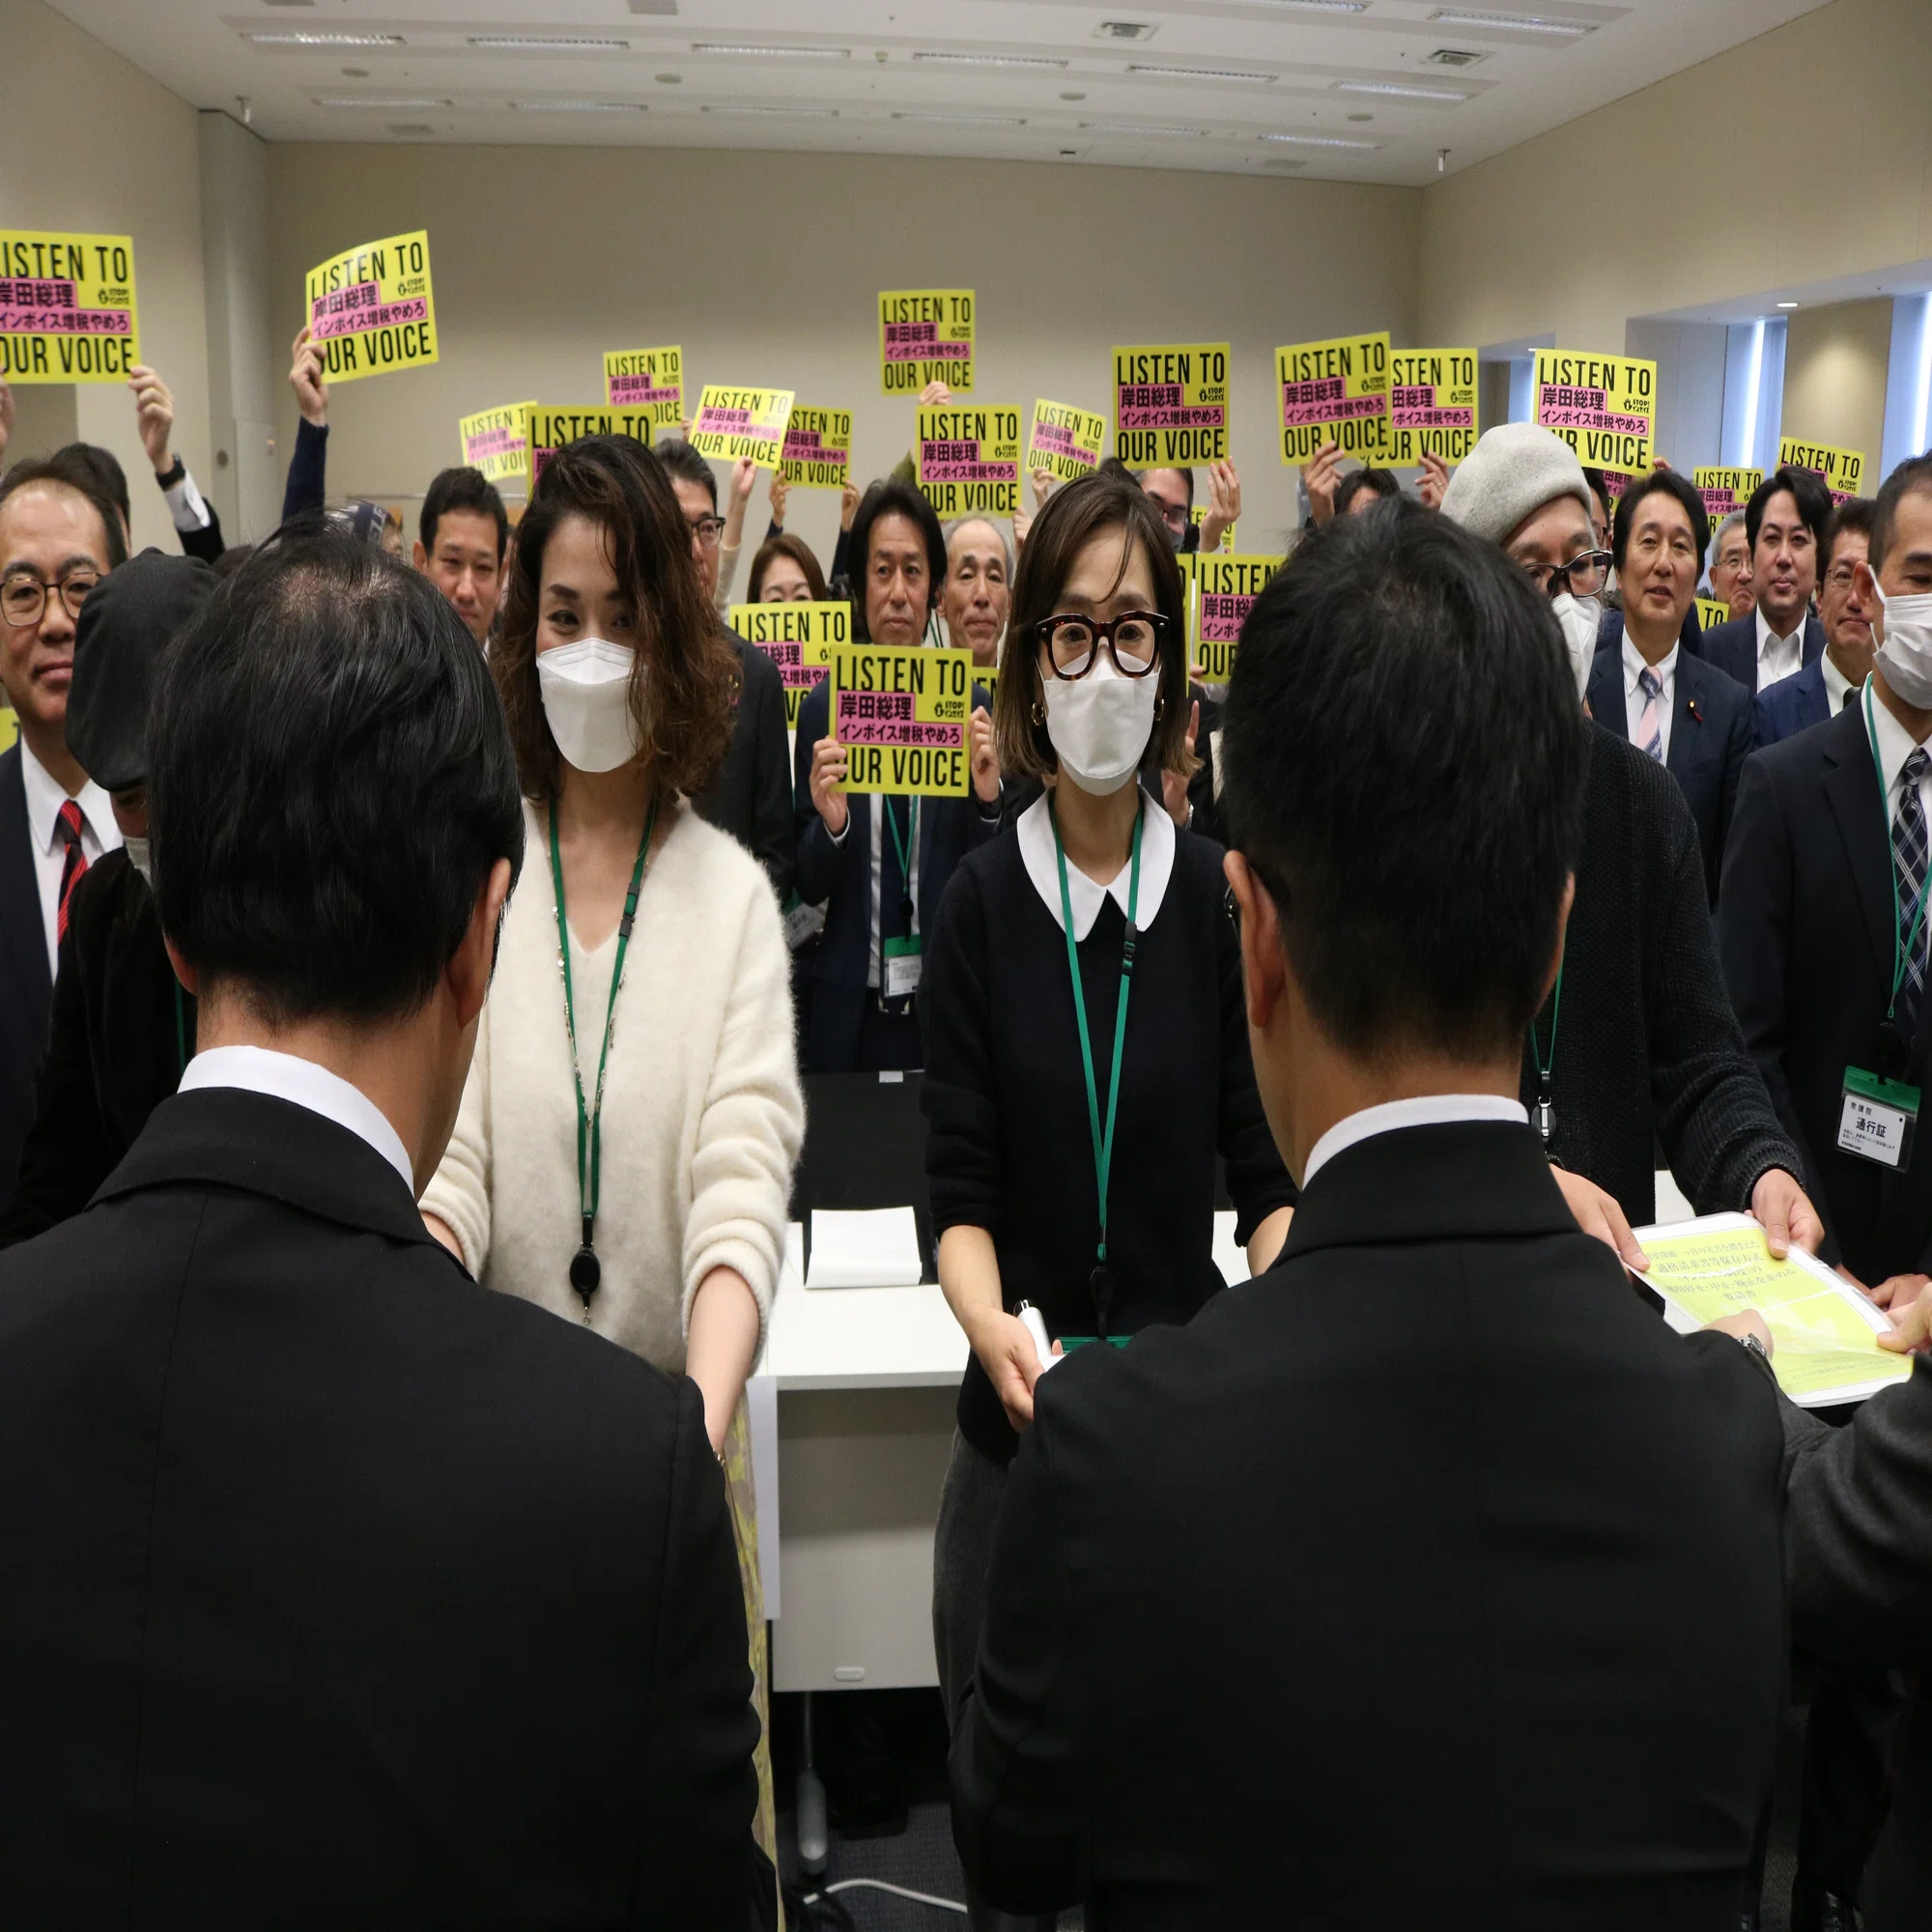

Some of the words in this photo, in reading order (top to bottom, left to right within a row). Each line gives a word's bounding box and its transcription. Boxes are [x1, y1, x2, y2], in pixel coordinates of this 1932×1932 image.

[0, 242, 84, 281] ISTEN
[95, 246, 128, 282] TO
[311, 250, 385, 302] LISTEN
[394, 242, 423, 276] TO
[314, 284, 377, 321] 岸田総理
[882, 298, 943, 324] LISTEN
[951, 297, 971, 323] TO
[315, 301, 425, 336] インボイス増税やめろ
[57, 337, 132, 374] VOICE
[320, 337, 356, 375] UR
[363, 322, 432, 366] VOICE
[607, 354, 656, 378] LISTEN
[662, 352, 679, 372] TO
[884, 363, 917, 389] OUR
[923, 361, 970, 387] VOICE
[1118, 354, 1190, 385] LISTEN
[1200, 352, 1225, 384] TO
[1281, 347, 1351, 384] LISTEN
[1360, 342, 1385, 374] TO
[1393, 357, 1441, 386] STEN
[1450, 356, 1473, 385] TO
[1540, 357, 1615, 391] LISTEN
[1625, 366, 1651, 397] TO
[703, 391, 761, 411] LISTEN
[769, 394, 789, 414] TO
[1122, 386, 1179, 408] 岸田総理
[1286, 380, 1343, 406] 岸田総理
[1392, 388, 1433, 409] 田総理
[1542, 387, 1605, 412] 岸田総理
[654, 402, 681, 423] ICE
[702, 409, 750, 423] 岸田総理
[787, 410, 828, 433] STEN
[834, 413, 850, 435] TO
[1037, 405, 1082, 433] LISTEN
[1087, 417, 1103, 440] TO
[1122, 409, 1222, 426] インボイス増税やめろ
[1287, 397, 1384, 423] インボイス増税やめろ
[1392, 411, 1471, 425] ボイス増税やめろ
[1542, 410, 1646, 434] インボイス増税やめろ
[465, 411, 512, 439] LISTEN
[622, 415, 649, 446] TO
[920, 413, 985, 441] LISTEN
[995, 412, 1017, 440] TO
[1285, 426, 1321, 458] OUR
[1329, 416, 1388, 451] VOICE
[692, 433, 724, 453] OUR
[729, 437, 779, 463] VOICE
[782, 447, 846, 462] ンボイス増税やめろ
[923, 442, 978, 462] 岸田総理
[1118, 431, 1157, 463] OUR
[1165, 428, 1224, 461] VOICE
[1419, 429, 1473, 459] VOICE
[1587, 431, 1648, 469] VOICE
[500, 450, 526, 471] VOI
[808, 462, 846, 485] VOICE
[923, 465, 1014, 478] インボイス増税やめろ
[1029, 450, 1053, 471] OUR
[1058, 456, 1093, 479] VOIC
[1781, 443, 1835, 473] LISTEN
[1841, 455, 1861, 479] TO
[1696, 471, 1741, 490] LISTEN
[1746, 472, 1761, 491] TO
[964, 483, 1017, 511] VOICE
[1204, 596, 1256, 619] 岸田総
[1705, 607, 1724, 630] TO
[819, 611, 845, 642] TO
[837, 655, 924, 694] LISTEN
[936, 659, 966, 696] TO
[840, 694, 912, 721] 岸田総理
[839, 724, 960, 745] インボイス増税やめろ
[893, 749, 963, 787] VOICE
